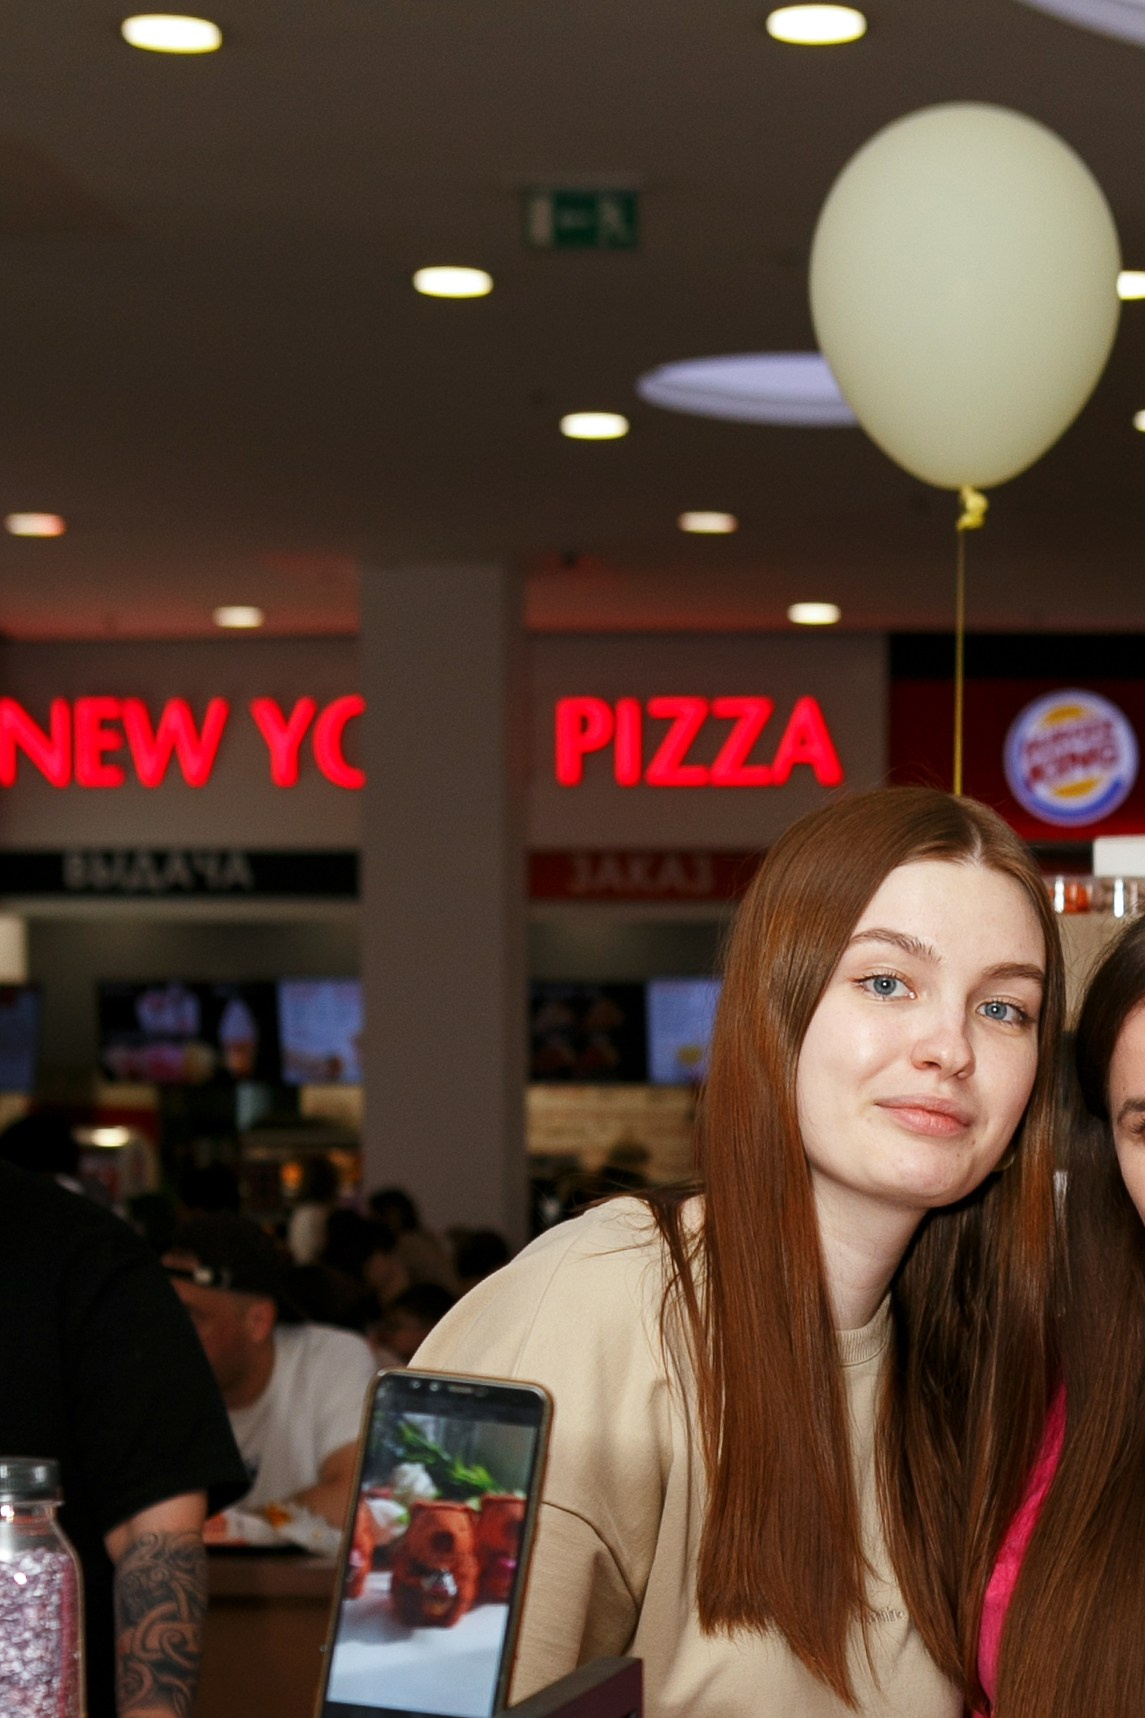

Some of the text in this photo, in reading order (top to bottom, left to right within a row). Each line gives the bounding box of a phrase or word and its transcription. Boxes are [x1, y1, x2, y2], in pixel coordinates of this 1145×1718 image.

[0, 696, 229, 789] NEW
[556, 695, 845, 787] PIZZA
[62, 850, 253, 892] ВЫДАЧА
[570, 851, 714, 892] ЗАКАЗ
